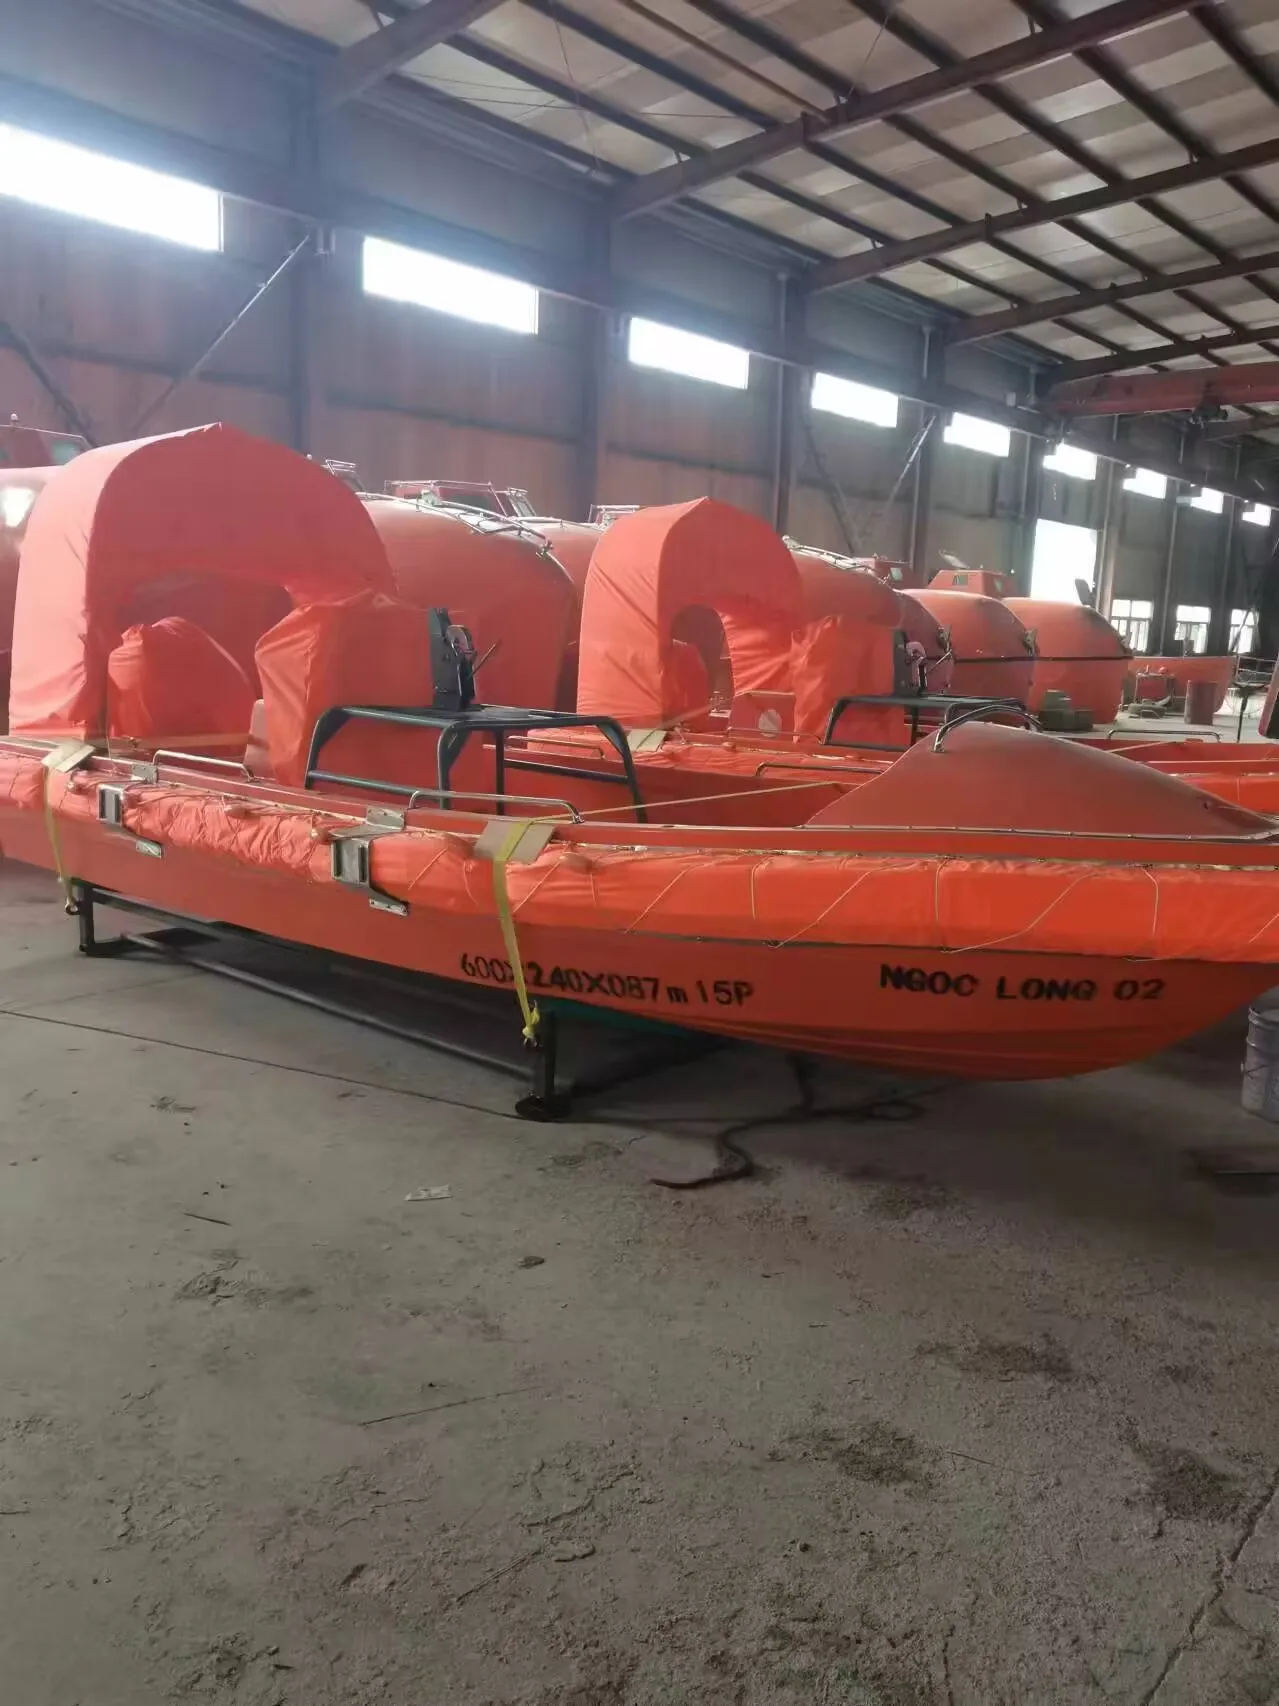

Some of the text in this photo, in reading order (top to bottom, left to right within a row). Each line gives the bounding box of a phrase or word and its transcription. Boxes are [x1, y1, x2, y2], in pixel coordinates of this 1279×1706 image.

[880, 963, 1165, 1002] NGOC LONG 02
